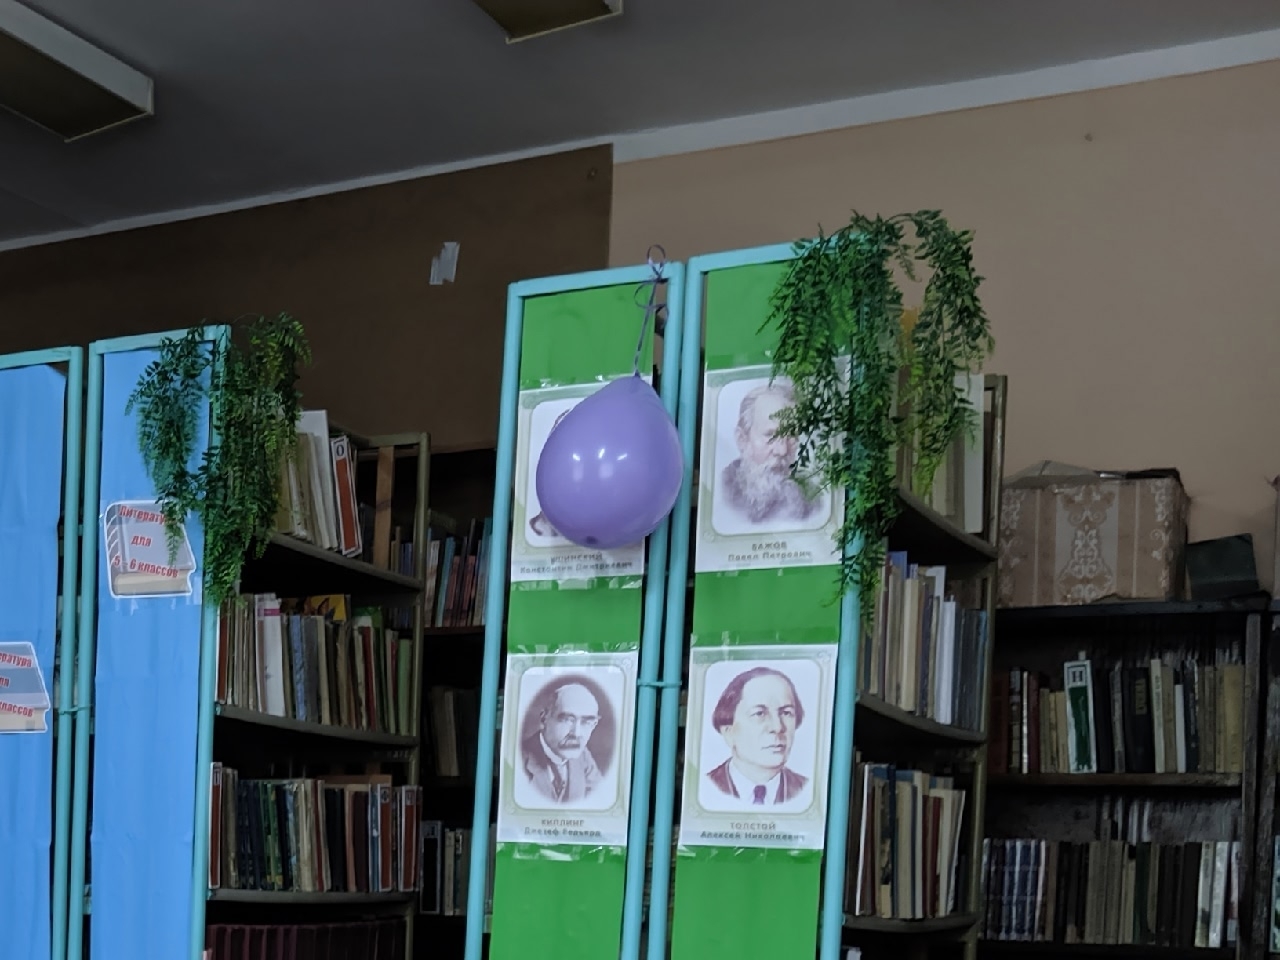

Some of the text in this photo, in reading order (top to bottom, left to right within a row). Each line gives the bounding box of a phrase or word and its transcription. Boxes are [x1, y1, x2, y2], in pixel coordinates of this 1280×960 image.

[131, 535, 152, 548] для
[114, 555, 120, 567] 5
[129, 559, 136, 570] 6
[138, 561, 179, 579] классов
